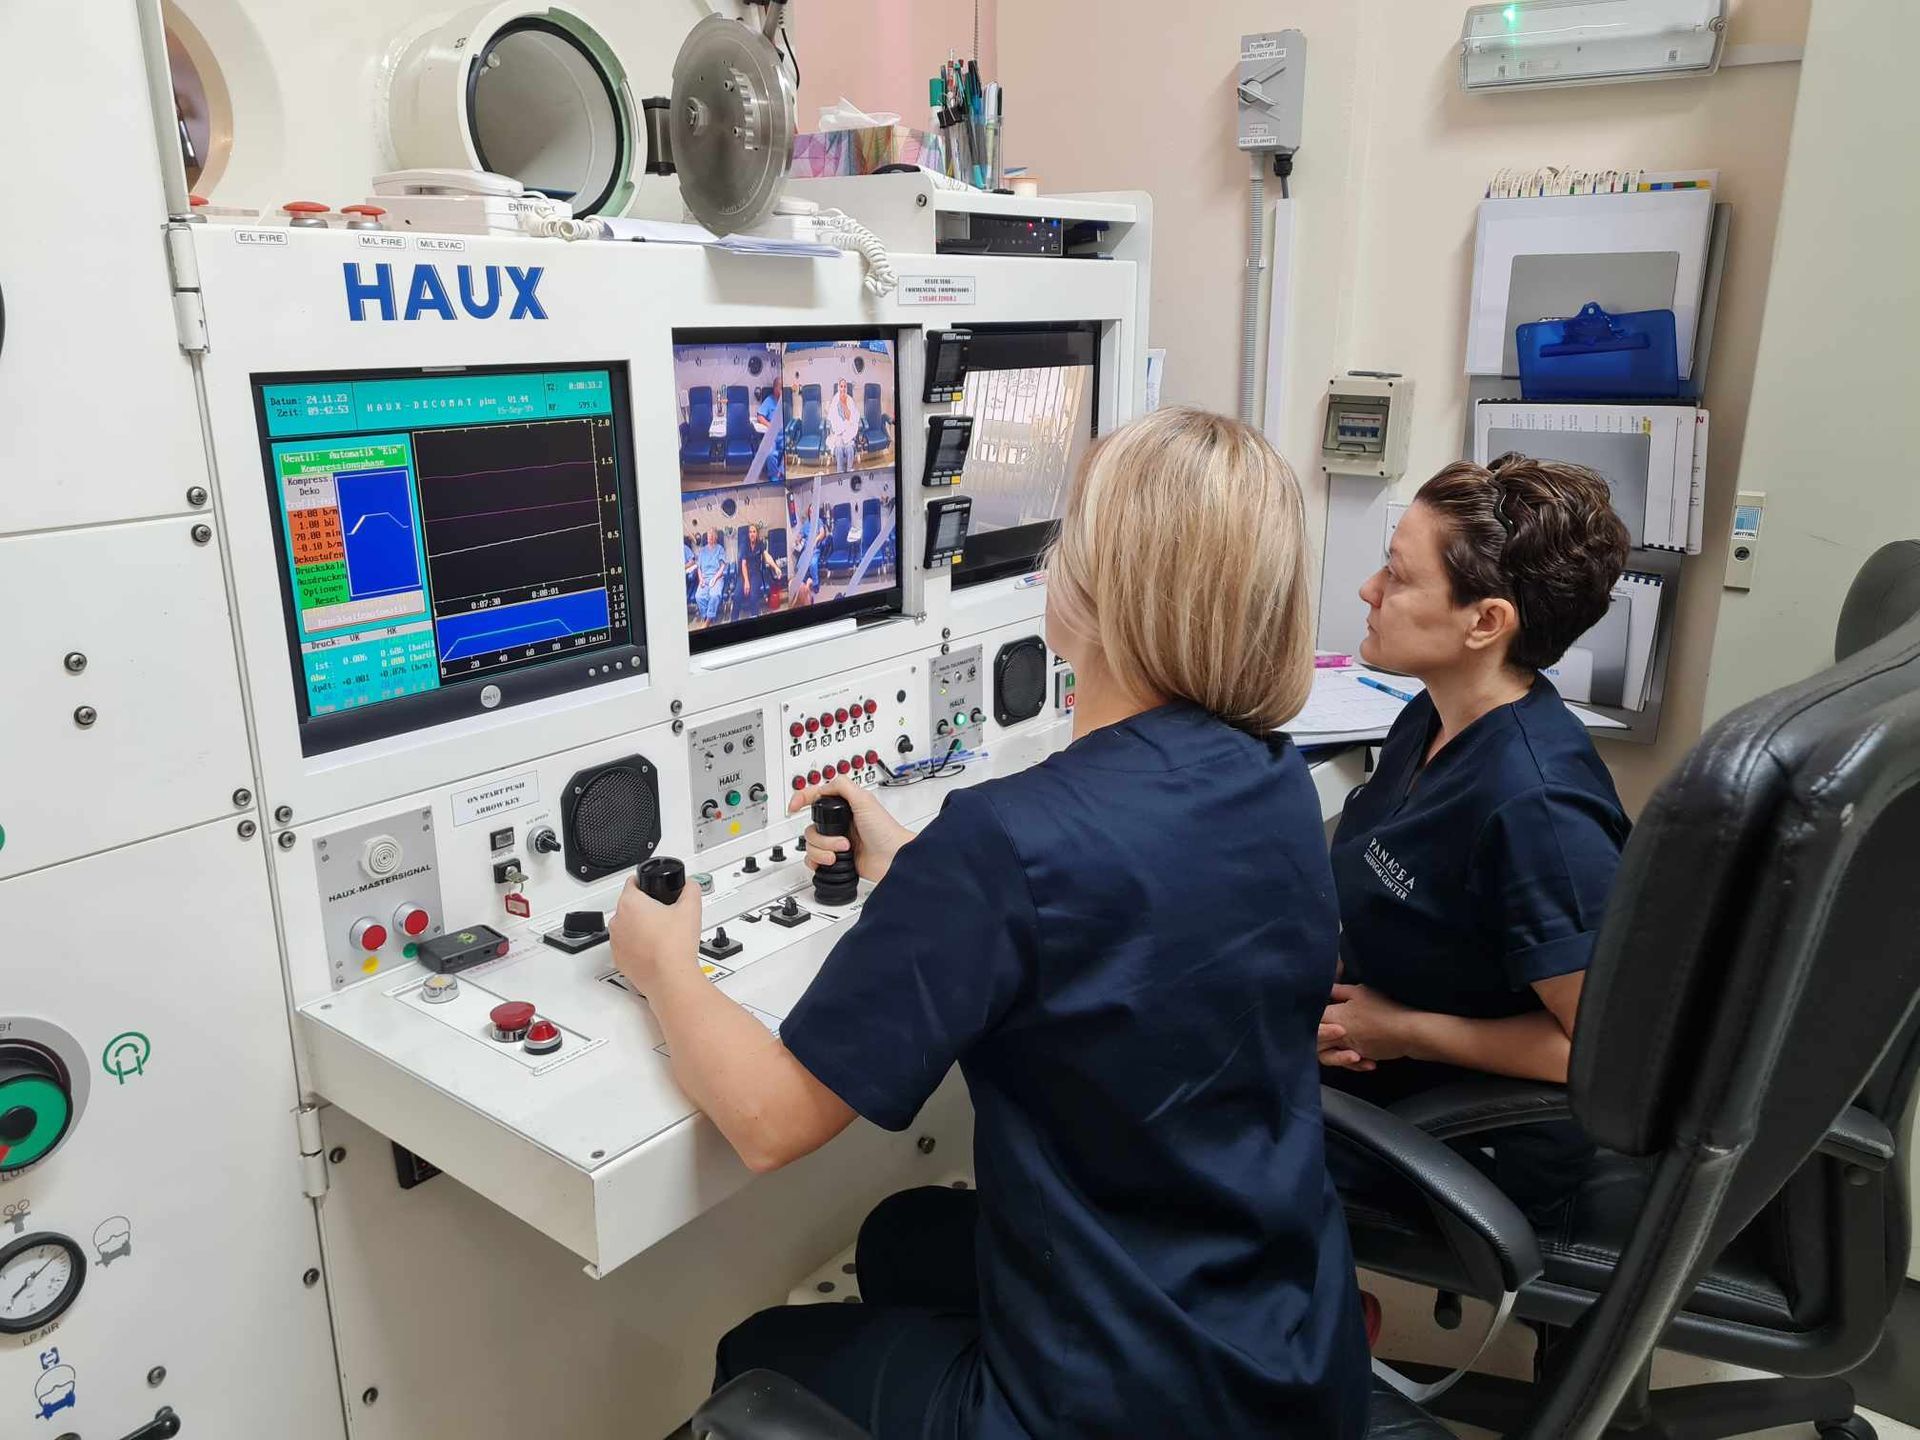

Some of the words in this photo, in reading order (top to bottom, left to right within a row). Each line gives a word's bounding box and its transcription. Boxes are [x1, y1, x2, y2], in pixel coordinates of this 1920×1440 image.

[508, 203, 534, 212] ENTRY
[239, 233, 256, 242] E/L
[258, 233, 284, 243] FIRE
[362, 237, 378, 246] M/L
[381, 238, 403, 247] FIRE
[420, 240, 437, 248] M/L
[438, 240, 462, 250] EVAC
[343, 262, 549, 321] HAUX
[270, 397, 301, 407] Datum:
[479, 396, 497, 407] plus
[276, 408, 303, 418] Zeit:
[598, 419, 611, 428] 2.0
[283, 452, 321, 463] Ventil:
[329, 447, 374, 460] Automatik
[301, 459, 385, 473] Kompressionsphase
[601, 457, 614, 466] 1.5
[299, 487, 320, 496] Deko
[604, 494, 617, 503] 1.0
[607, 530, 620, 539] 0.5
[294, 552, 344, 564] Dekostufen
[610, 566, 623, 575] 0.0
[303, 584, 344, 596] Optionen
[612, 584, 624, 593] 2.0
[614, 593, 625, 602] 1.5
[614, 602, 625, 611] 1.0
[614, 610, 626, 619] 0.5
[311, 638, 341, 650] Druck:
[470, 659, 480, 669] 20
[498, 654, 508, 663] 40
[526, 648, 535, 657] 60
[574, 637, 586, 646] 100
[702, 724, 753, 744] HAUX-TALKMASTER
[719, 772, 741, 787] HAUX
[467, 796, 479, 804] ON
[480, 788, 505, 801] START
[505, 782, 525, 793] PUSH
[475, 801, 504, 815] ARROW
[504, 796, 520, 807] KEY
[1369, 837, 1416, 890] PANACEA
[1363, 852, 1385, 878] MEDICAL
[1381, 874, 1408, 900] CENTER
[329, 864, 432, 903] HAUX-MASTERSIGNAL
[22, 1332, 38, 1347] LP
[40, 1322, 60, 1337] AIR
